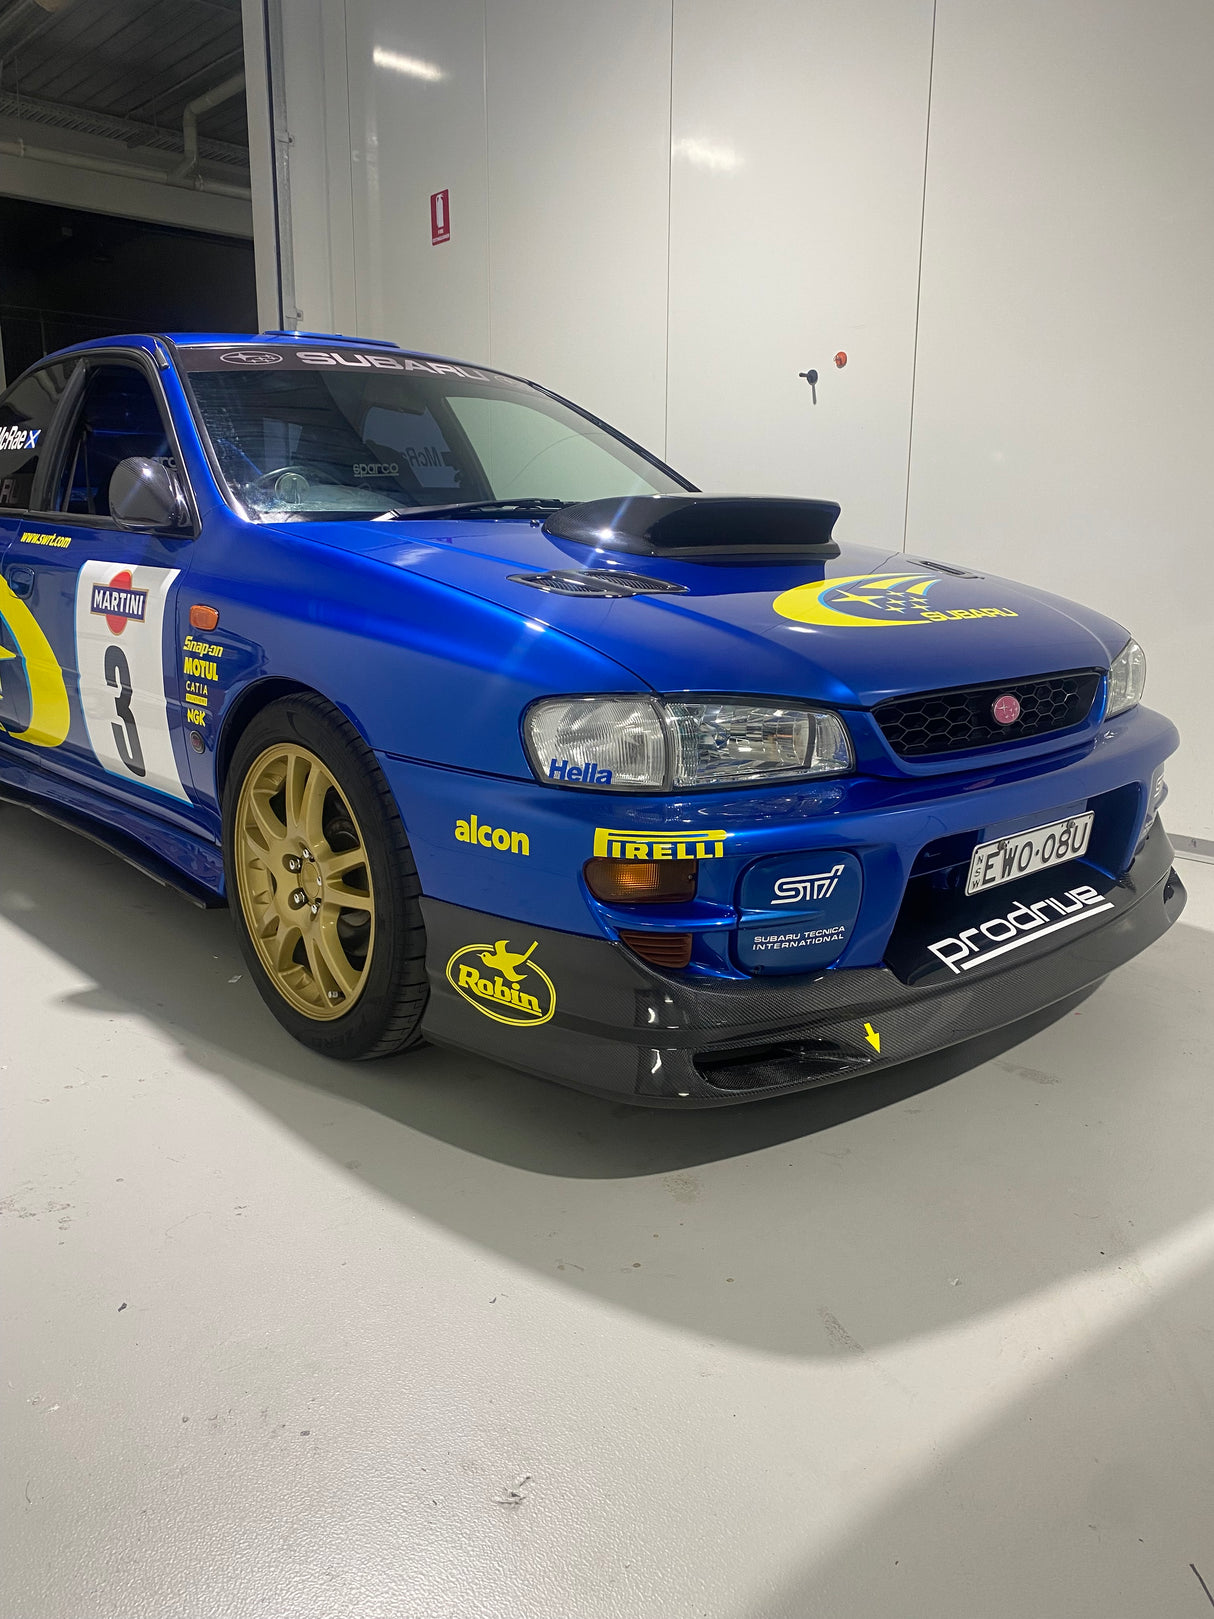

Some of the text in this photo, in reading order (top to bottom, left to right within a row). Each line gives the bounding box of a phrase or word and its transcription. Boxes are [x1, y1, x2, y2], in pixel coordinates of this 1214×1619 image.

[296, 351, 491, 382] SUBARU
[353, 463, 399, 477] sparco
[93, 589, 144, 615] MARTINI
[920, 607, 1018, 622] SUBARU
[183, 635, 223, 657] Snap-on
[183, 656, 219, 681] MOTUL
[185, 680, 208, 695] CATIA
[104, 645, 146, 777] 3
[187, 707, 206, 727] NGK
[549, 758, 612, 784] Hella
[454, 815, 530, 856] alcon
[593, 827, 727, 860] PIRELLI
[754, 926, 845, 943] SUBARU TECNICA
[927, 885, 1106, 974] prodrive
[752, 934, 844, 951] INTERNATIONAL
[458, 964, 542, 1014] Robin
